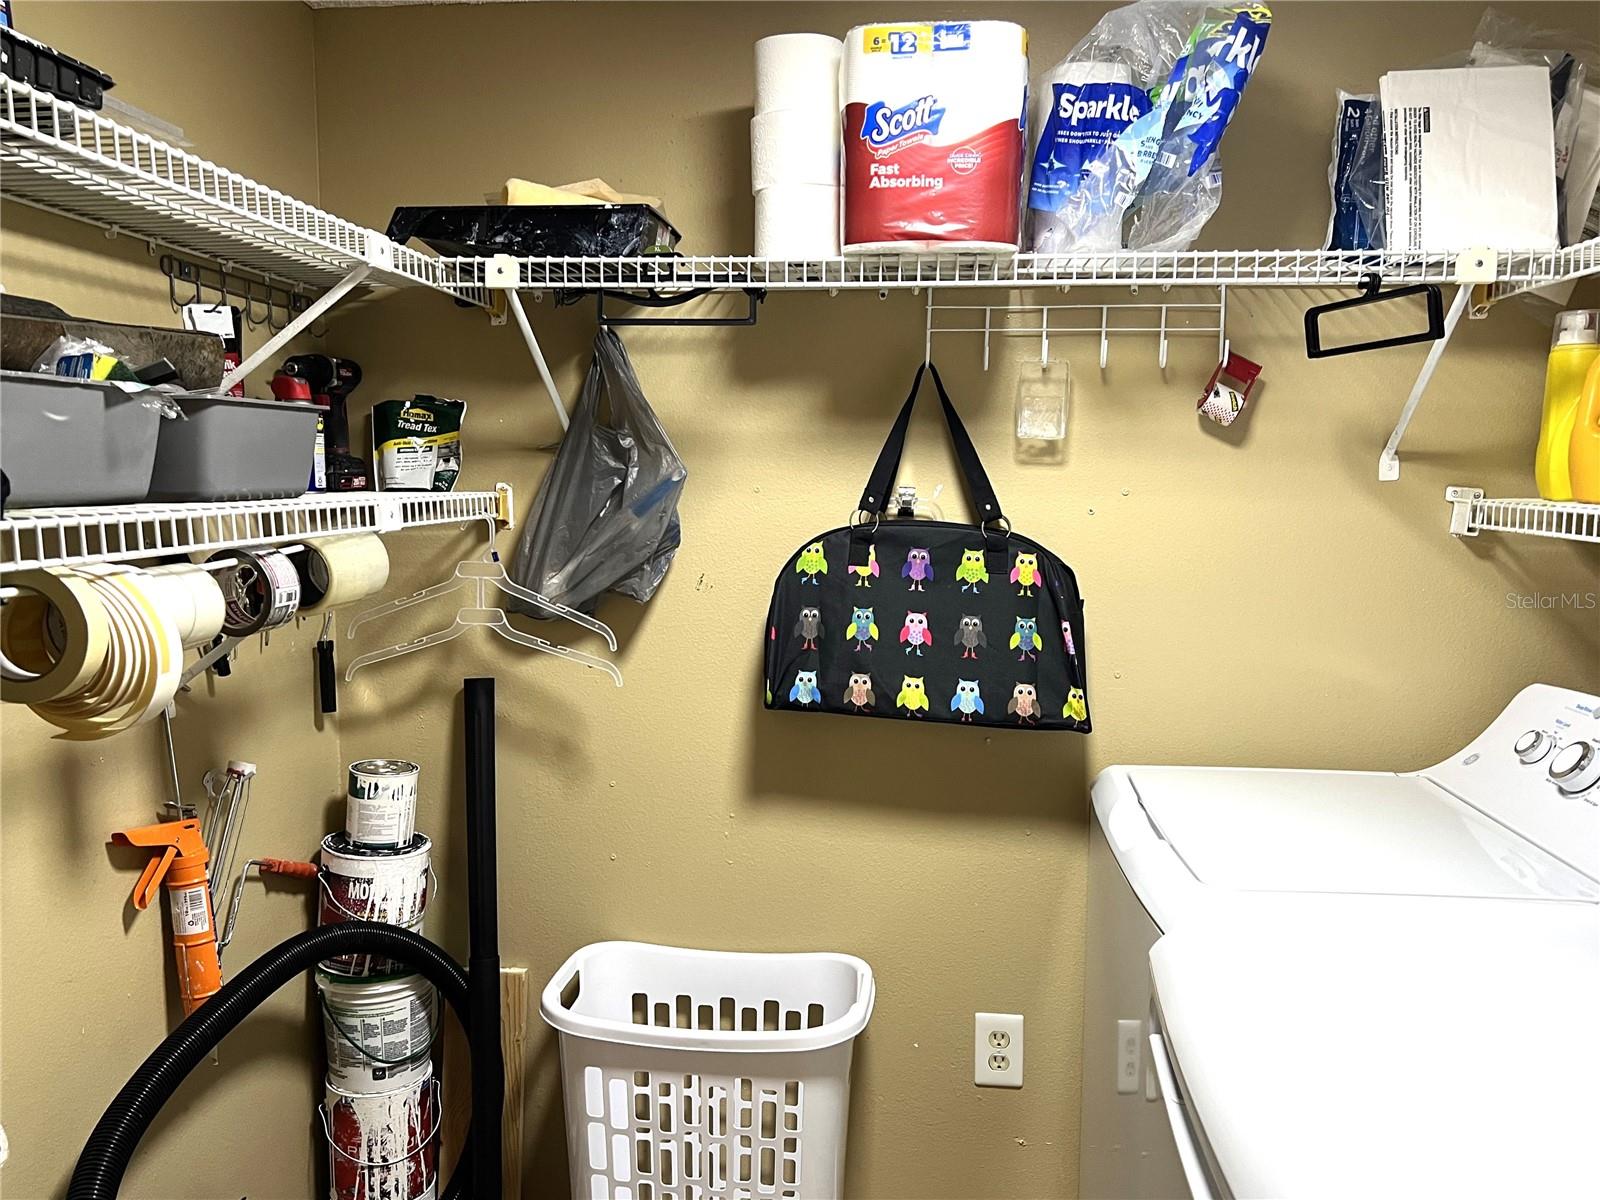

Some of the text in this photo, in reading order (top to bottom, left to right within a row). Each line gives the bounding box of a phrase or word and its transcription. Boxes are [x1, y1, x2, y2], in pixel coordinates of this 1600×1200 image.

[873, 32, 917, 54] 6 12
[1059, 92, 1140, 126] Sparkle
[871, 95, 936, 143] Scott
[870, 163, 900, 175] Fast
[869, 174, 944, 191] Absorbing
[397, 419, 438, 433] Tread Tex
